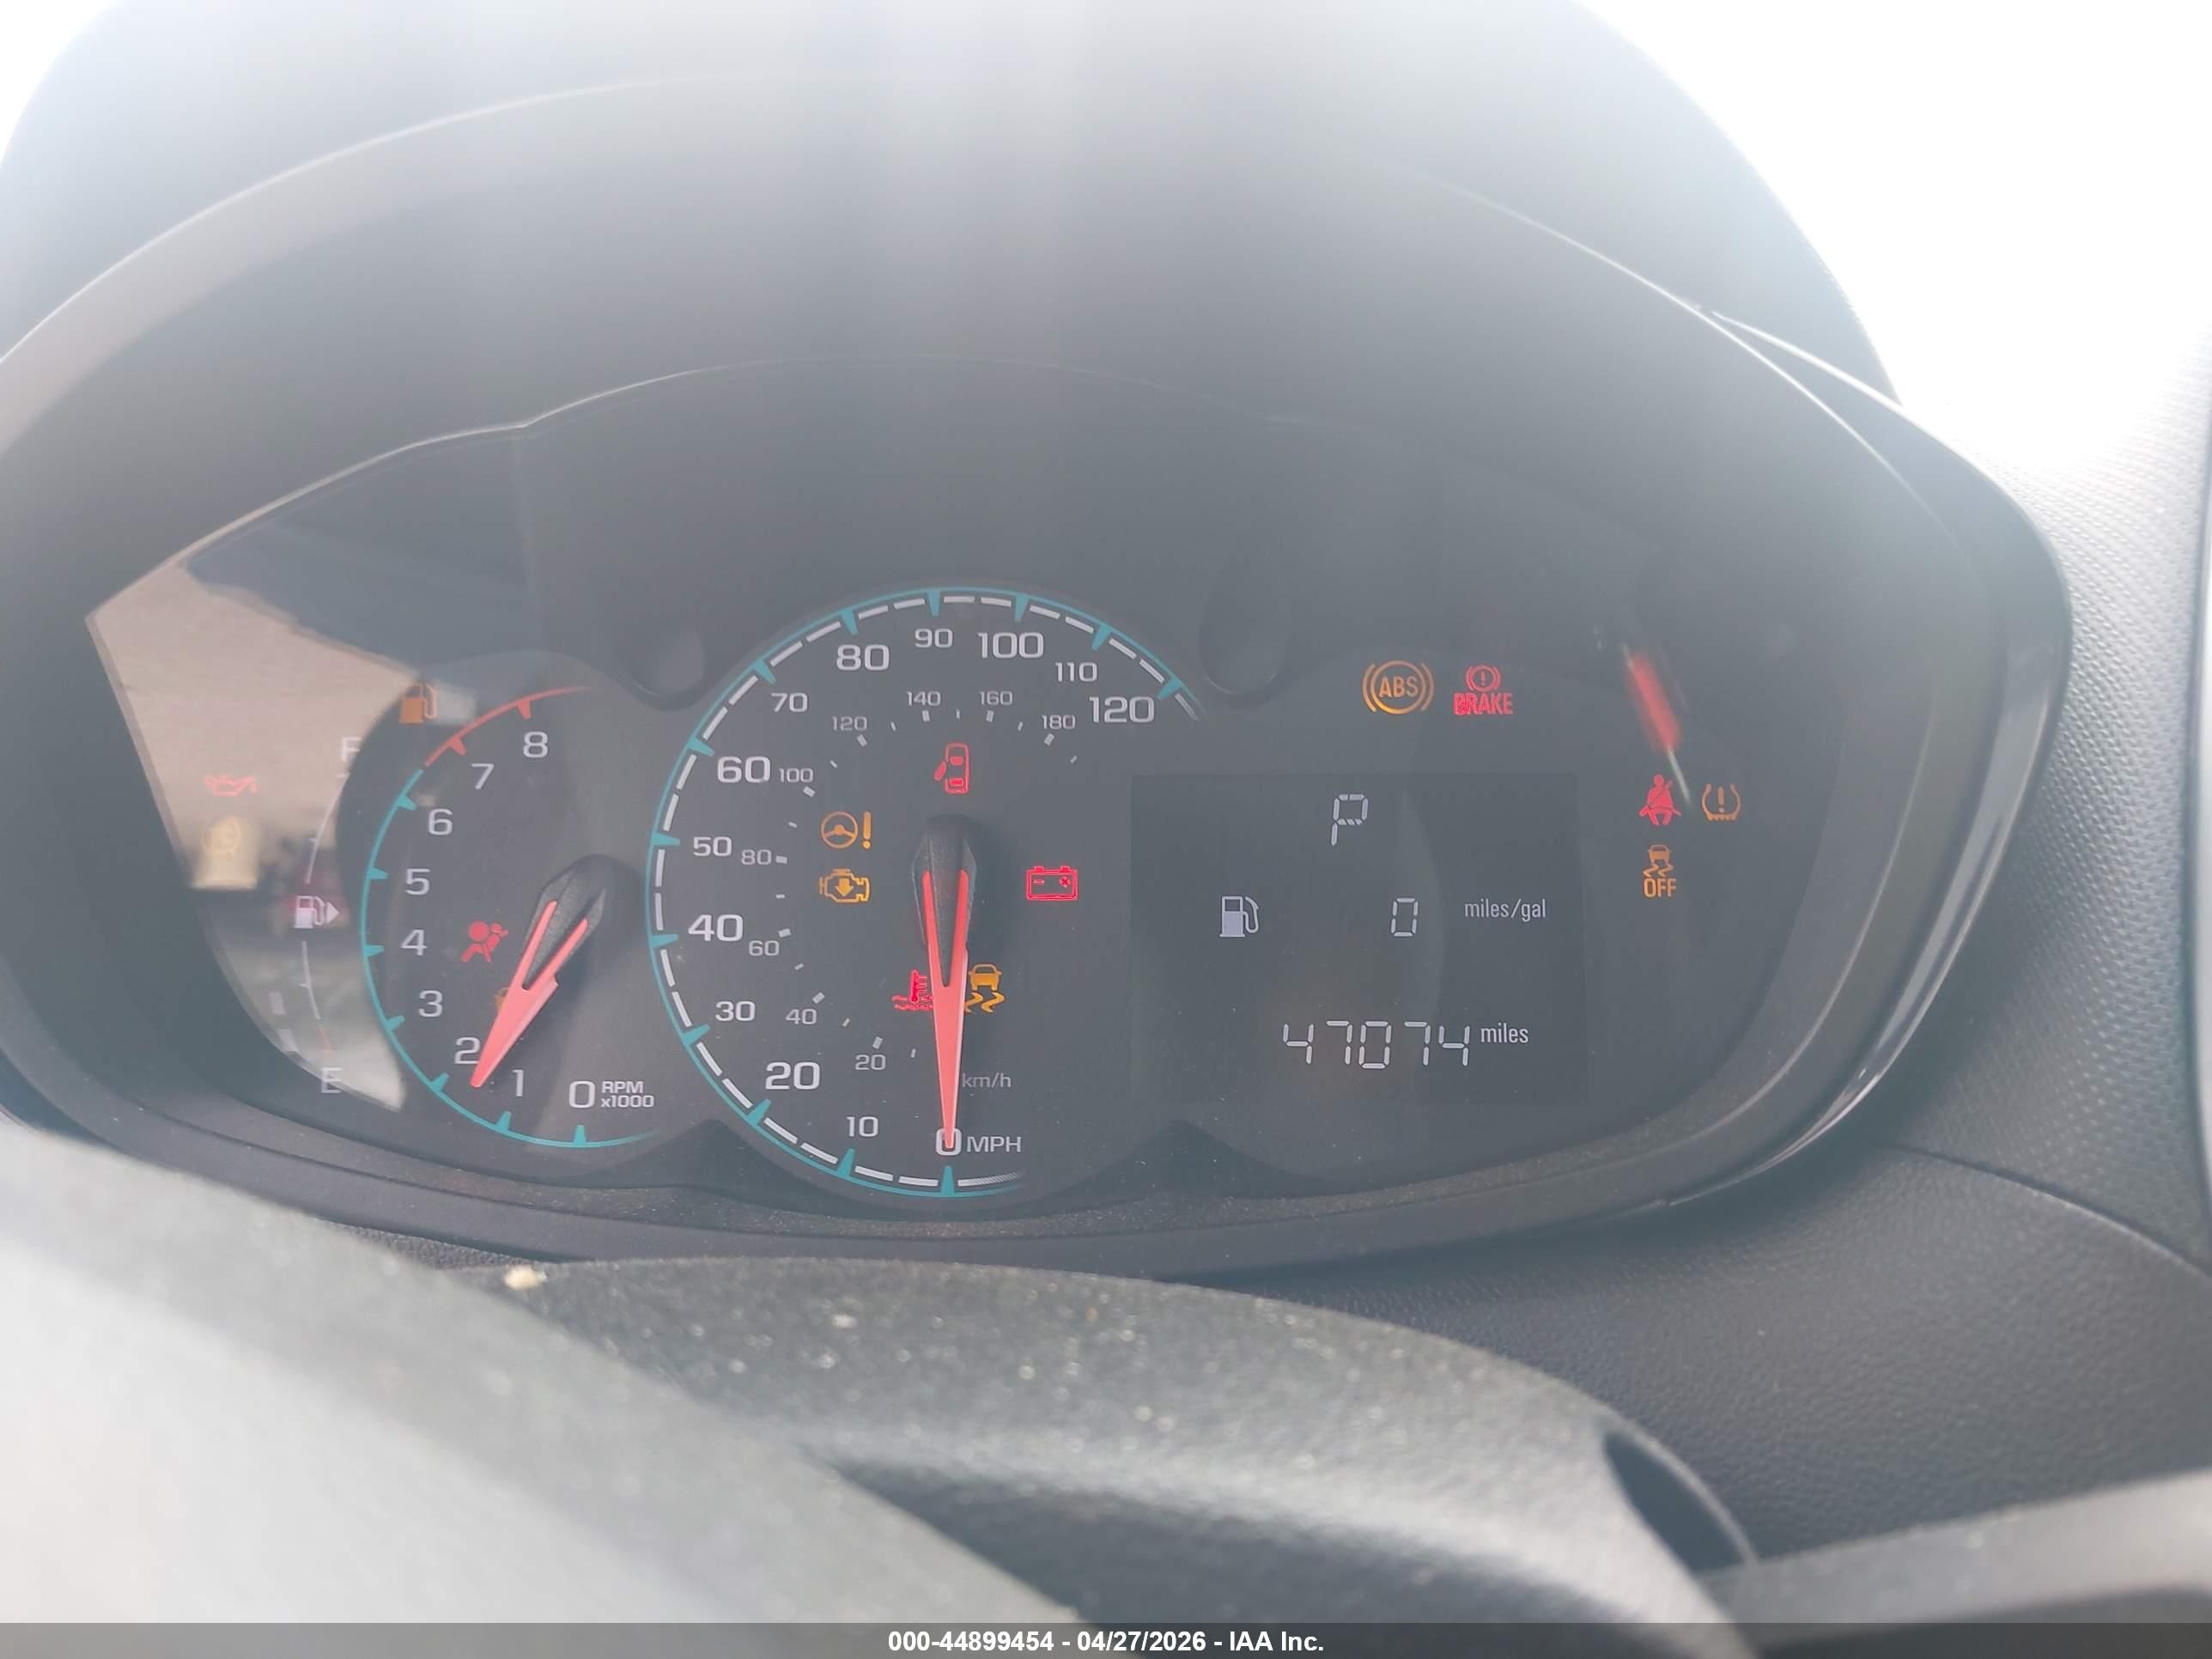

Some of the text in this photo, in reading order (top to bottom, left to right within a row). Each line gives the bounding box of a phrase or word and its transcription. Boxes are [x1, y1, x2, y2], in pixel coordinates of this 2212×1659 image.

[915, 629, 953, 649] 90
[978, 632, 1044, 659] 100
[836, 644, 890, 672] 80
[1055, 661, 1097, 683] 110
[1378, 676, 1419, 697] ABS
[772, 693, 809, 713] 70
[906, 690, 941, 707] 140
[979, 690, 1013, 707] 160
[1454, 693, 1513, 715] BRAKE
[1089, 696, 1155, 724] 120
[832, 716, 868, 732] 120
[1041, 714, 1077, 731] 180
[342, 738, 362, 761] F
[523, 732, 549, 758] 8
[471, 763, 495, 790] 7
[717, 756, 771, 783] 60
[779, 767, 814, 784] 100
[429, 809, 453, 835] 6
[1331, 793, 1369, 846] P
[693, 836, 732, 857] 50
[740, 849, 772, 866] 80
[405, 868, 430, 896] 5
[1644, 878, 1676, 897] OFF
[1390, 897, 1547, 937] 0 miles/gal
[688, 915, 744, 943] 40
[402, 929, 427, 956] 4
[748, 940, 780, 957] 60
[418, 990, 443, 1017] 3
[715, 1000, 756, 1022] 30
[786, 1009, 817, 1025] 40
[455, 1037, 480, 1064] 2
[1283, 1020, 1528, 1069] 47074 miles
[855, 1054, 887, 1071] 20
[321, 1067, 341, 1094] E
[513, 1070, 524, 1097] 1
[765, 1061, 821, 1090] 20
[962, 1072, 1012, 1089] km/h
[569, 1080, 596, 1109] 0
[603, 1081, 643, 1095] RPM
[602, 1095, 654, 1109] x1000
[847, 1116, 879, 1138] 10
[935, 1127, 1022, 1157] 0 MPH
